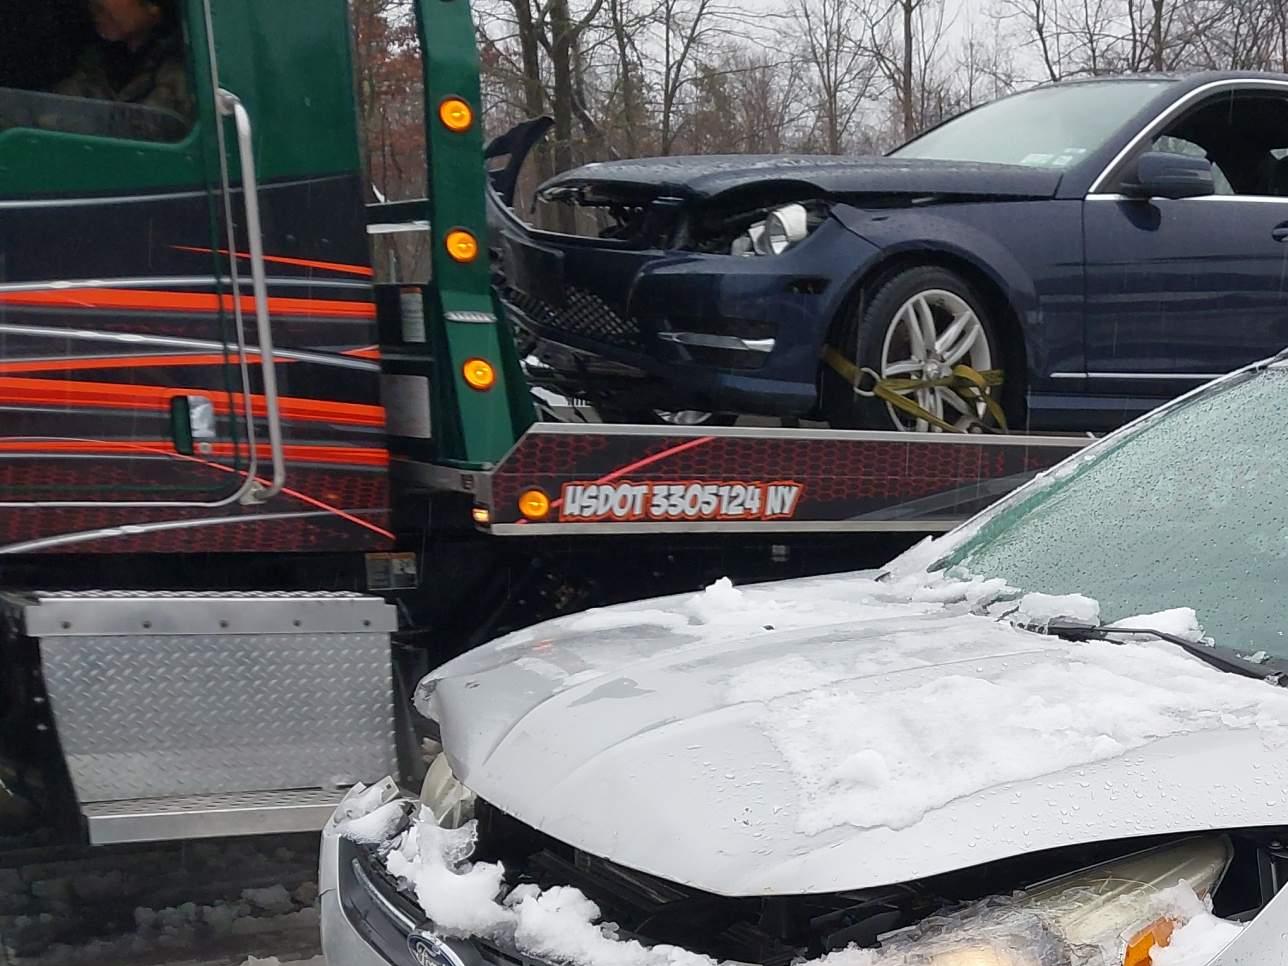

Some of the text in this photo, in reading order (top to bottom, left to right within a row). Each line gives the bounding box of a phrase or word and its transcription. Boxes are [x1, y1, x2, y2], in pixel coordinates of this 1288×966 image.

[563, 484, 800, 516] USDOT 3305124 NY
